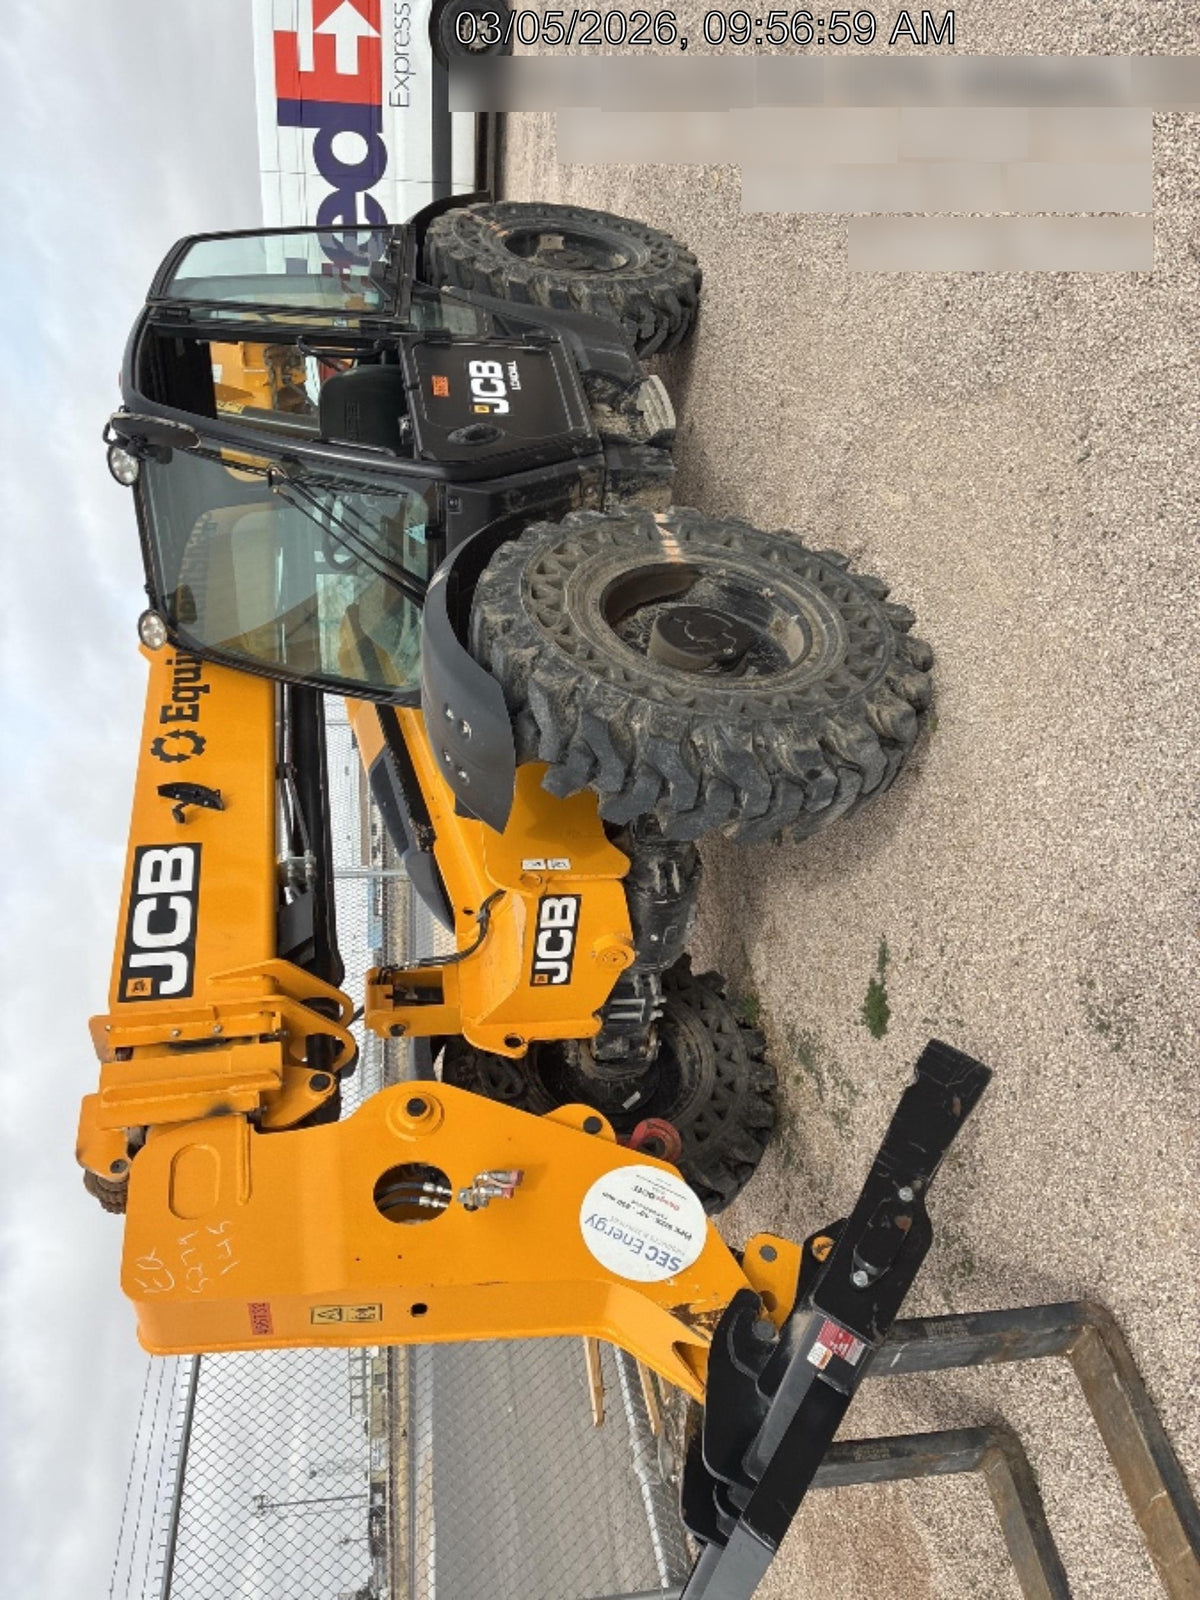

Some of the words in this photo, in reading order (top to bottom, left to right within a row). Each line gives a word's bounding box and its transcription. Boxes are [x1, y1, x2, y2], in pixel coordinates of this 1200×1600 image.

[388, 2, 416, 108] Express
[469, 360, 509, 413] JCB
[128, 847, 194, 994] JCB
[534, 897, 577, 984] JCB
[584, 1213, 645, 1254] Energy
[645, 1246, 682, 1272] SEC
